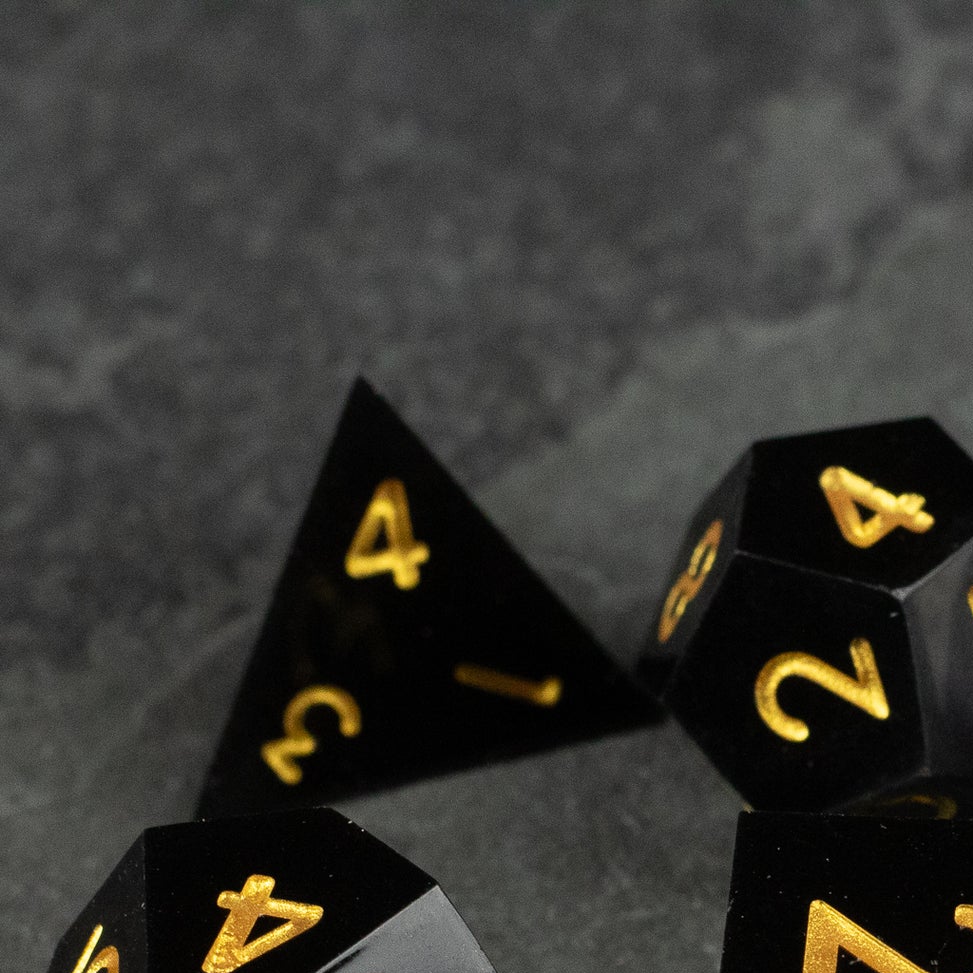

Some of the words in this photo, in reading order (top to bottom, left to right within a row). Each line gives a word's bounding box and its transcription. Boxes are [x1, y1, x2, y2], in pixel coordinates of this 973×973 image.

[344, 478, 431, 590] 4
[818, 465, 936, 549] 4
[455, 663, 562, 706] 1
[754, 637, 891, 743] 2
